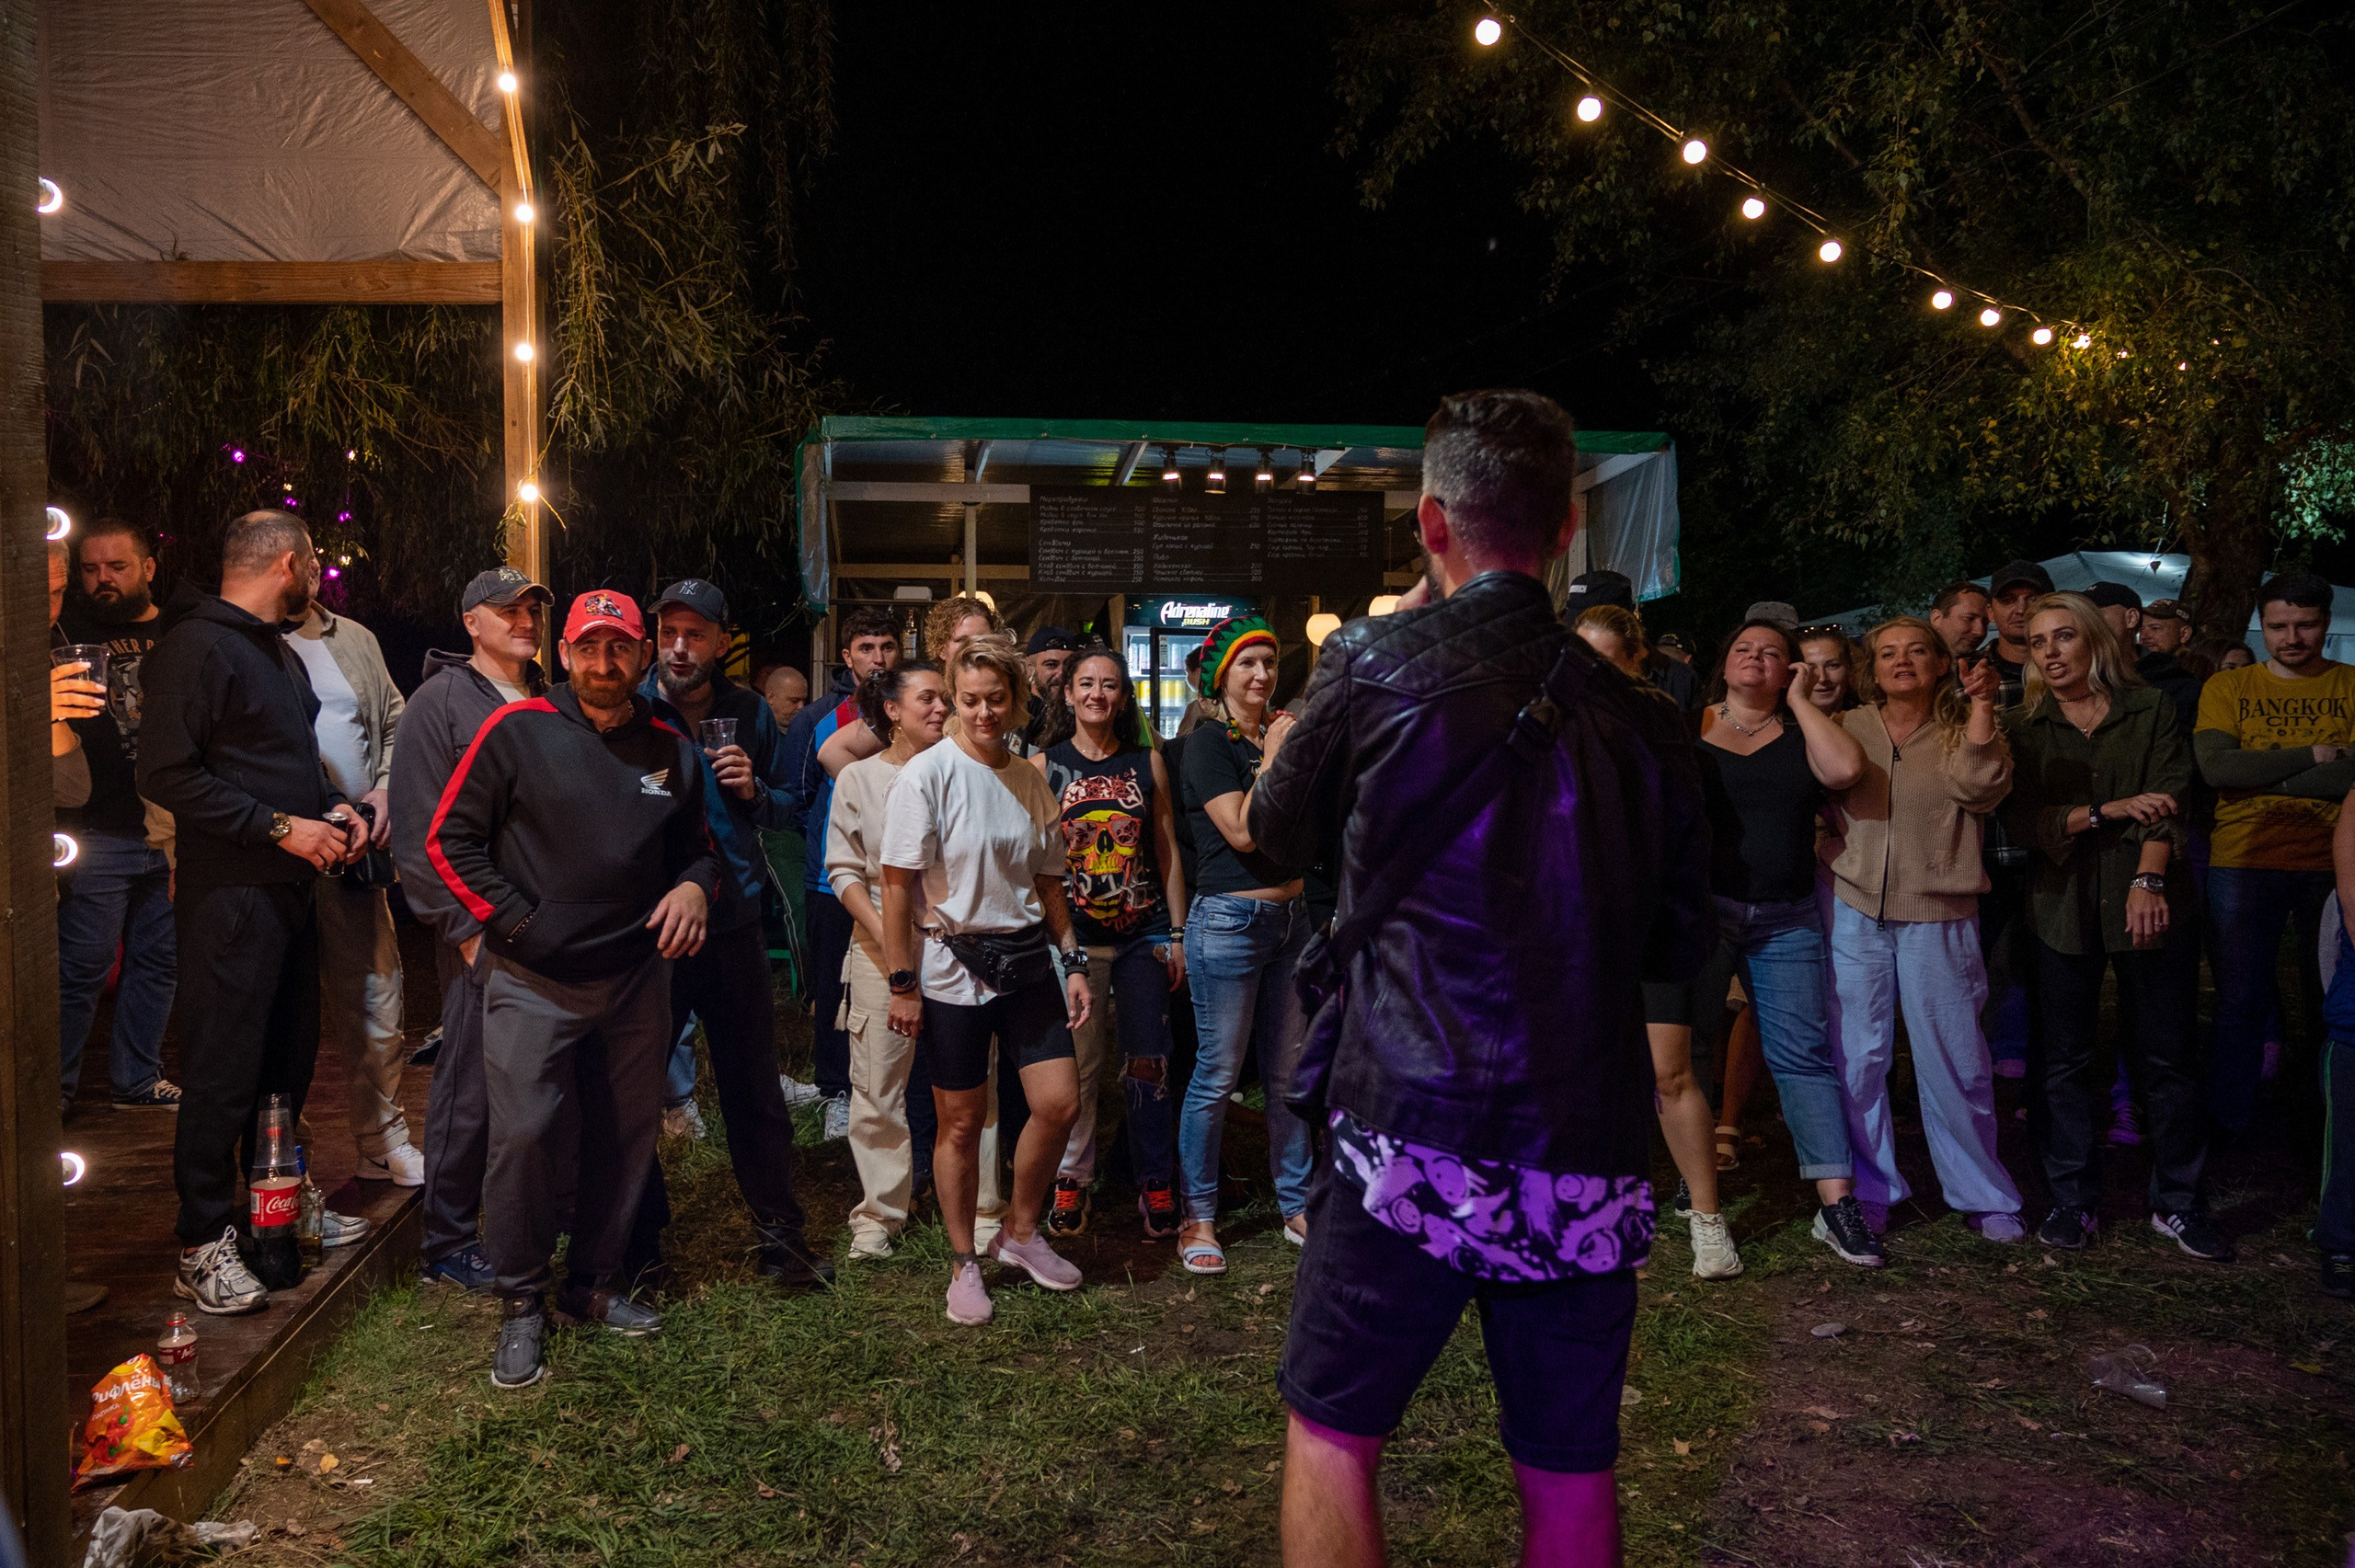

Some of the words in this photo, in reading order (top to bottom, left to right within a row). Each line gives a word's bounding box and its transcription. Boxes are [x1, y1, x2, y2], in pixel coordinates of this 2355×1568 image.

[1160, 601, 1232, 625] Adrenaline
[1181, 617, 1211, 626] RUSH
[2238, 697, 2348, 723] BANGKOK
[2266, 715, 2320, 727] CITY
[640, 787, 672, 797] HONDA
